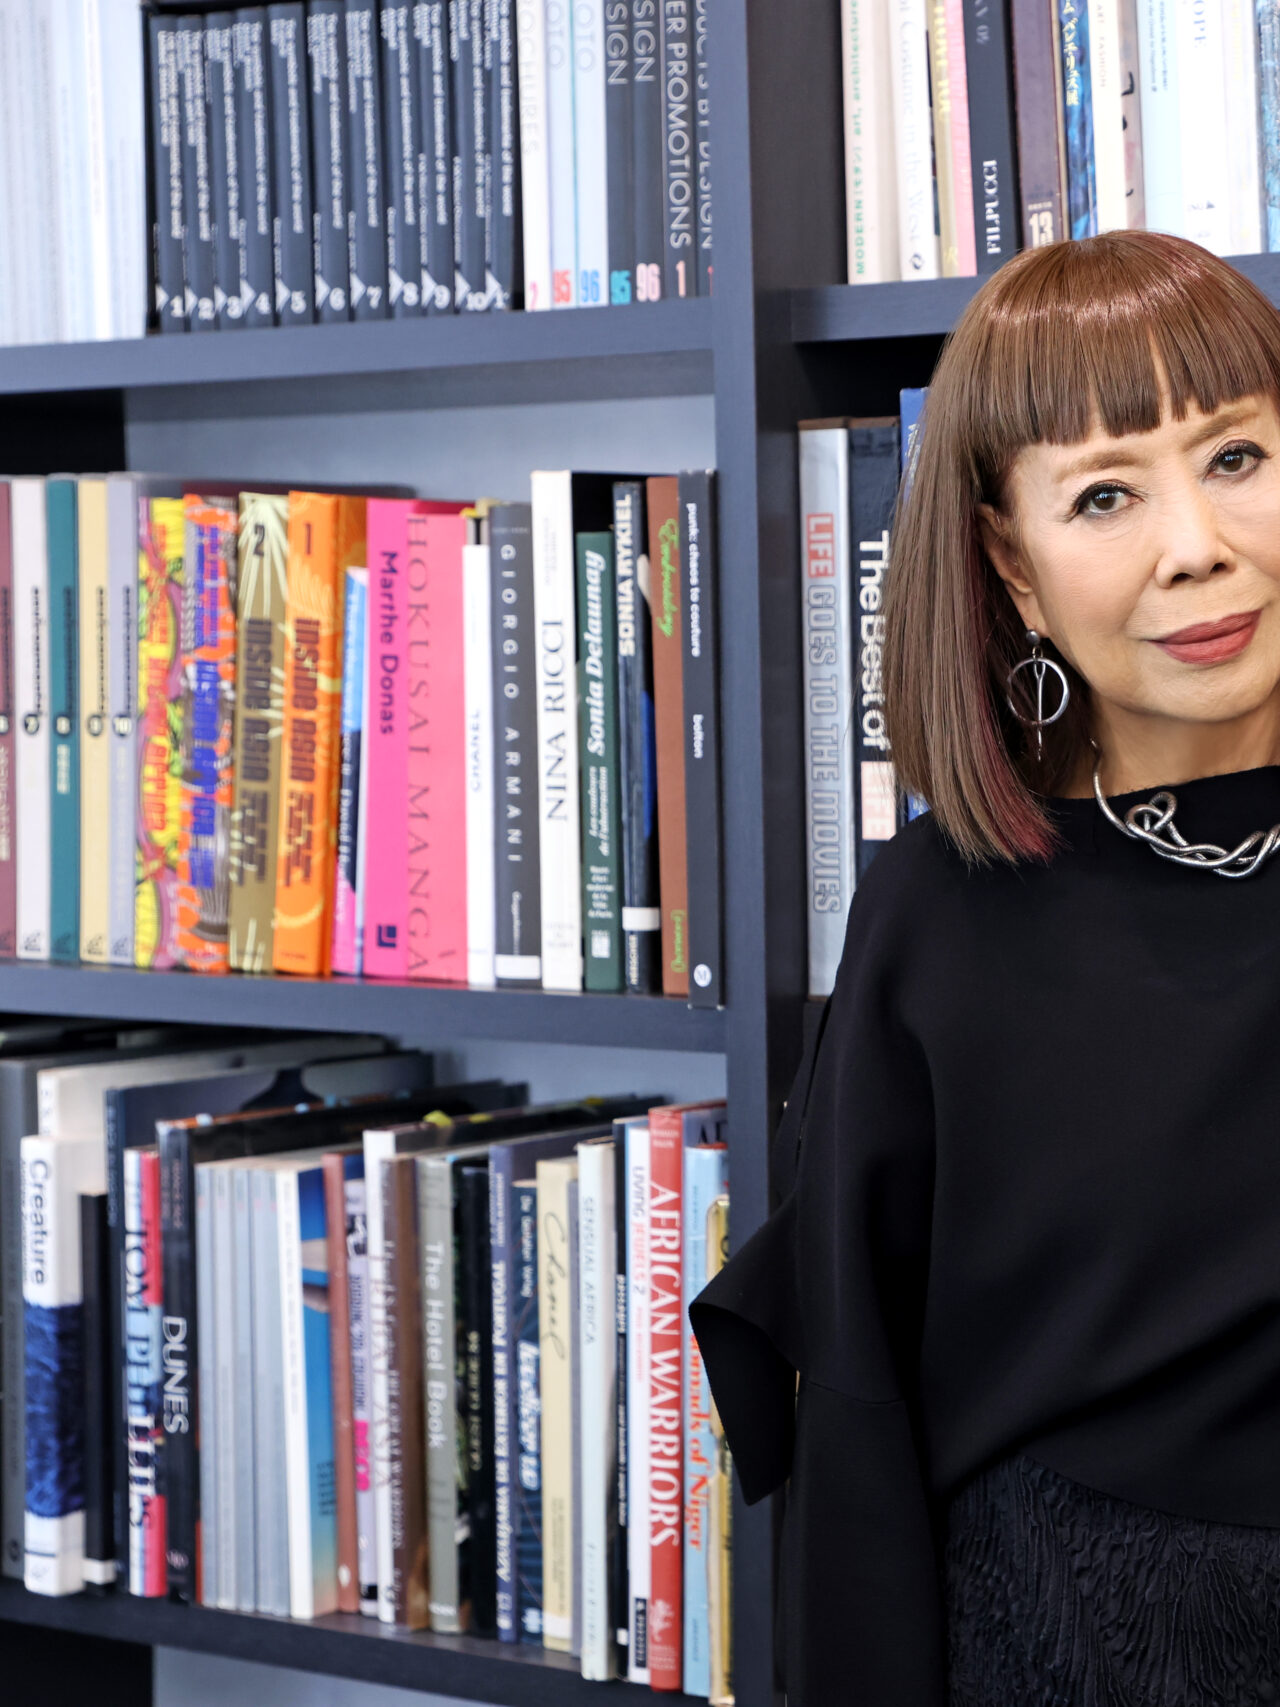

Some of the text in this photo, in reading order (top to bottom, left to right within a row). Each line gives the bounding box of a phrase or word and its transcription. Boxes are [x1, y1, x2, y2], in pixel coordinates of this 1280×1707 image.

[666, 43, 693, 249] PROMOTIONS
[378, 551, 401, 736] Marthe Donas
[584, 549, 608, 758] Sonia Delaunay
[614, 493, 636, 657] SONIA RYKIEL
[688, 543, 702, 658] chaos couture
[406, 515, 431, 973] HOKUSAI MANGA
[469, 708, 483, 794] CHANEL
[499, 543, 524, 865] GIORGIO ARMANI
[540, 618, 568, 823] NINA RICCI
[807, 514, 842, 915] LIFE GOES TO THE MOVIES
[858, 529, 895, 839] The Best of LIFE
[28, 1158, 51, 1285] Creature
[543, 1210, 568, 1362] Chanel
[581, 1194, 597, 1346] SENSUAL AFRICA
[631, 1164, 646, 1281] LIVING JEWELS
[124, 1225, 157, 1531] TOM PHILLIPS
[161, 1314, 189, 1434] DUNES
[424, 1240, 450, 1449] The Hotel Book
[491, 1259, 513, 1583] AZULEJARIA DE EXTERIOR PORTUGAL
[648, 1179, 680, 1547] AFRICAN WARRIORS
[684, 1437, 711, 1553] of Niger
